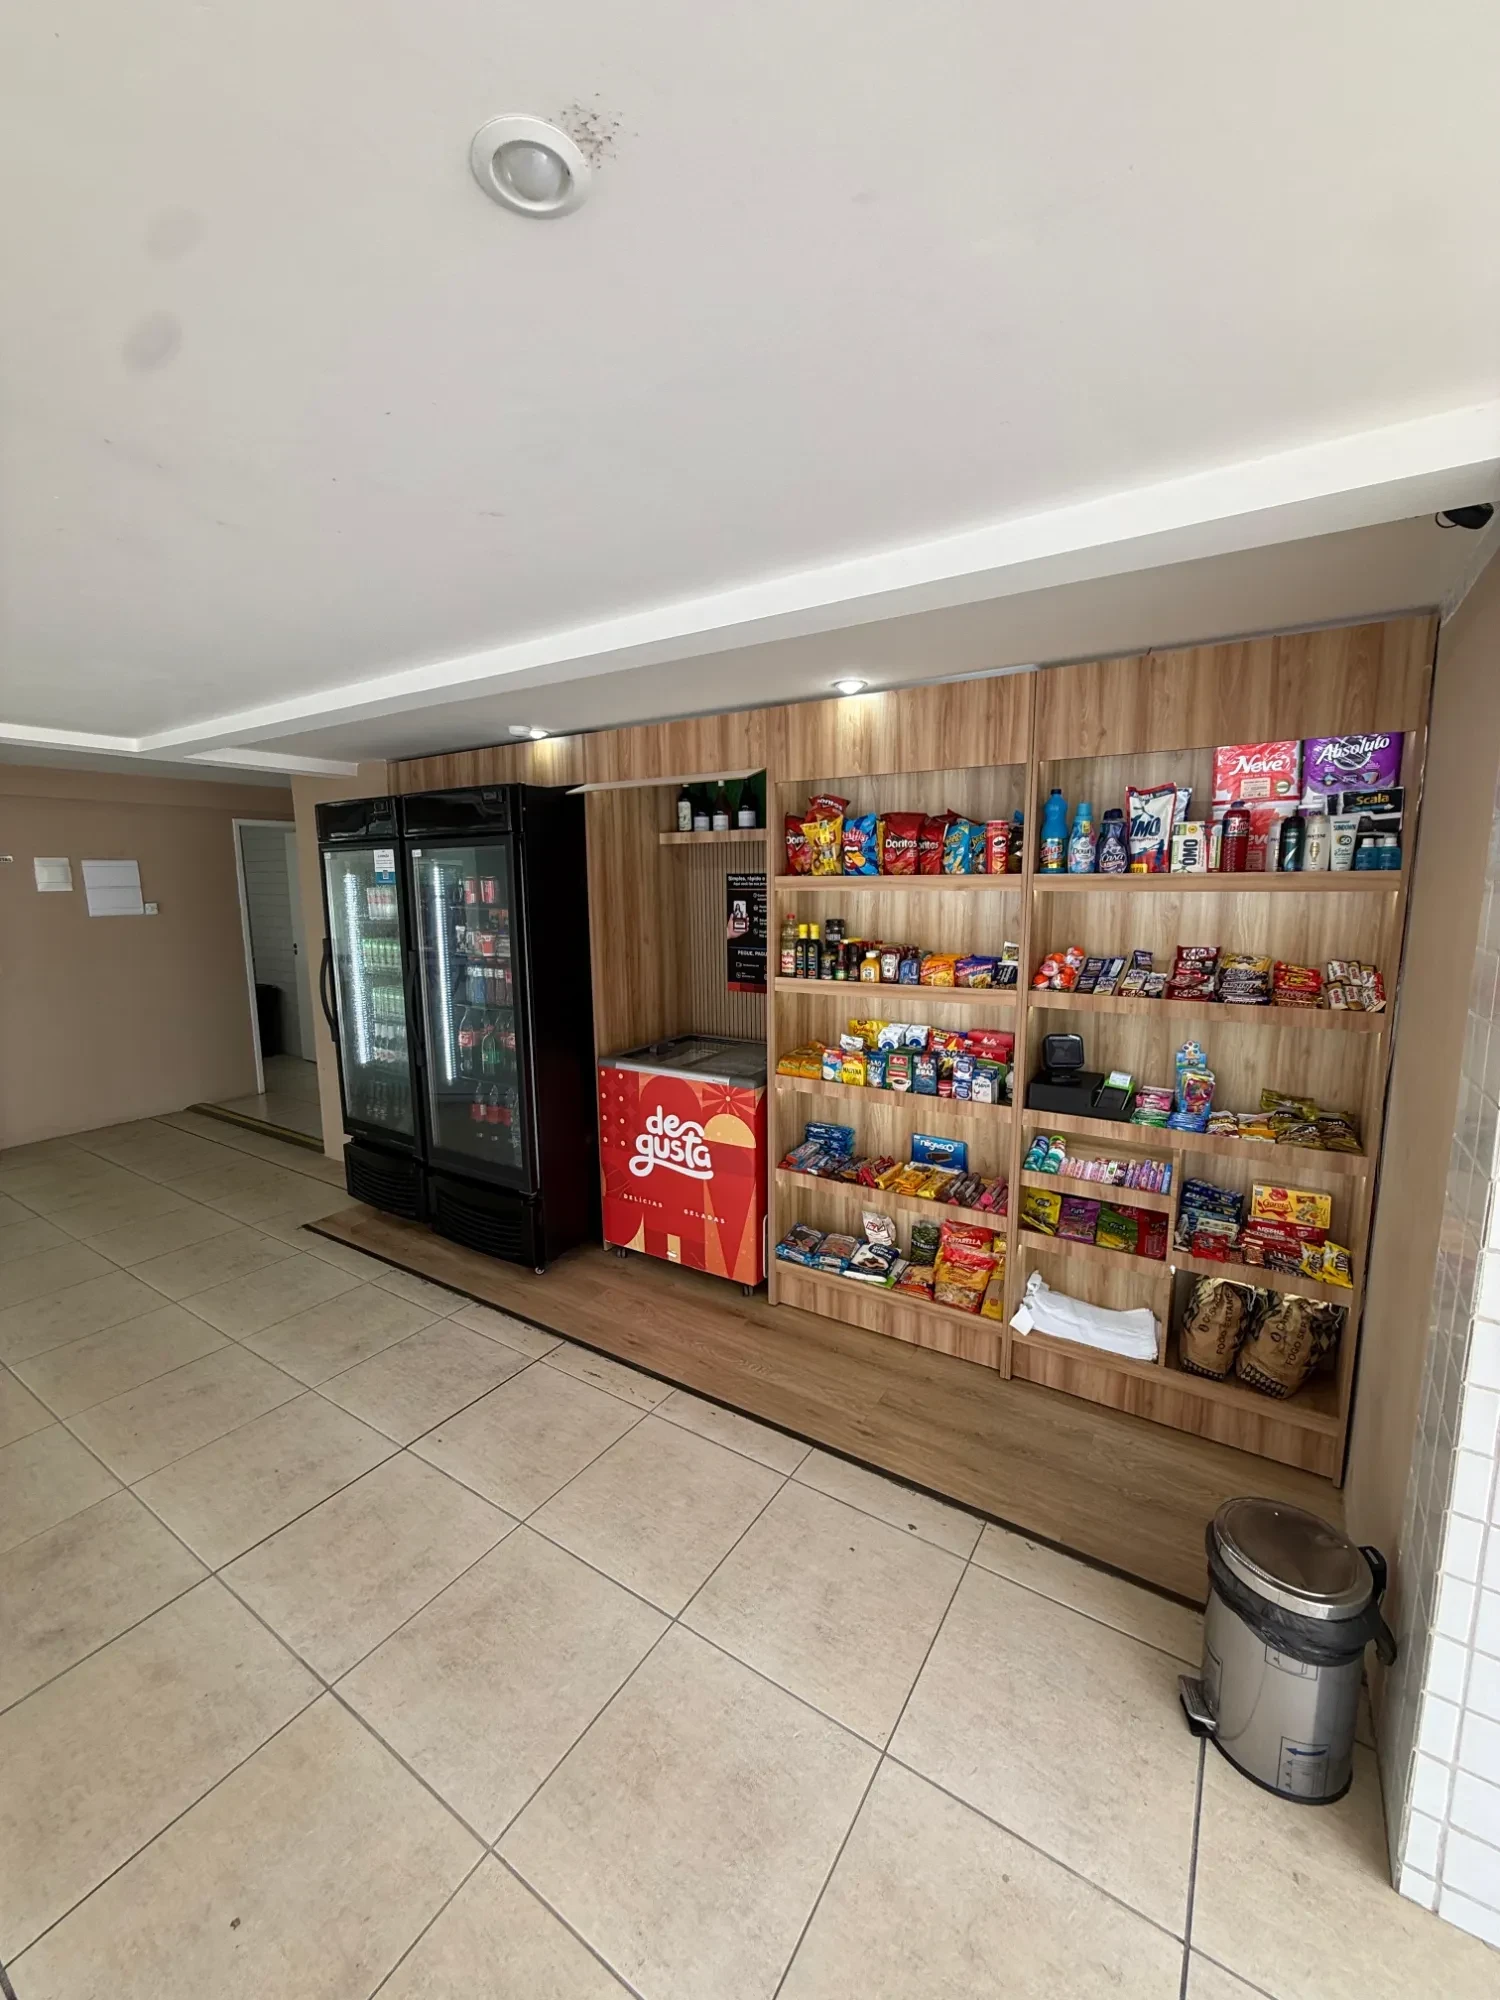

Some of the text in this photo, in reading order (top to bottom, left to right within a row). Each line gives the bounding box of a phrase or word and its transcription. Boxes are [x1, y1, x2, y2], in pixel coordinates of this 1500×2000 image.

[1315, 735, 1390, 765] Absoluto
[1228, 754, 1284, 775] Neve
[1356, 793, 1390, 805] Scala
[843, 828, 870, 843] uffles
[885, 839, 917, 849] Doritos
[1340, 835, 1352, 845] 50
[1182, 839, 1198, 866] OMO
[646, 1105, 704, 1138] de
[629, 1131, 714, 1180] gusta
[623, 1193, 725, 1224] DELÍCIAS GELADAS
[1286, 1341, 1302, 1366] FOGO
